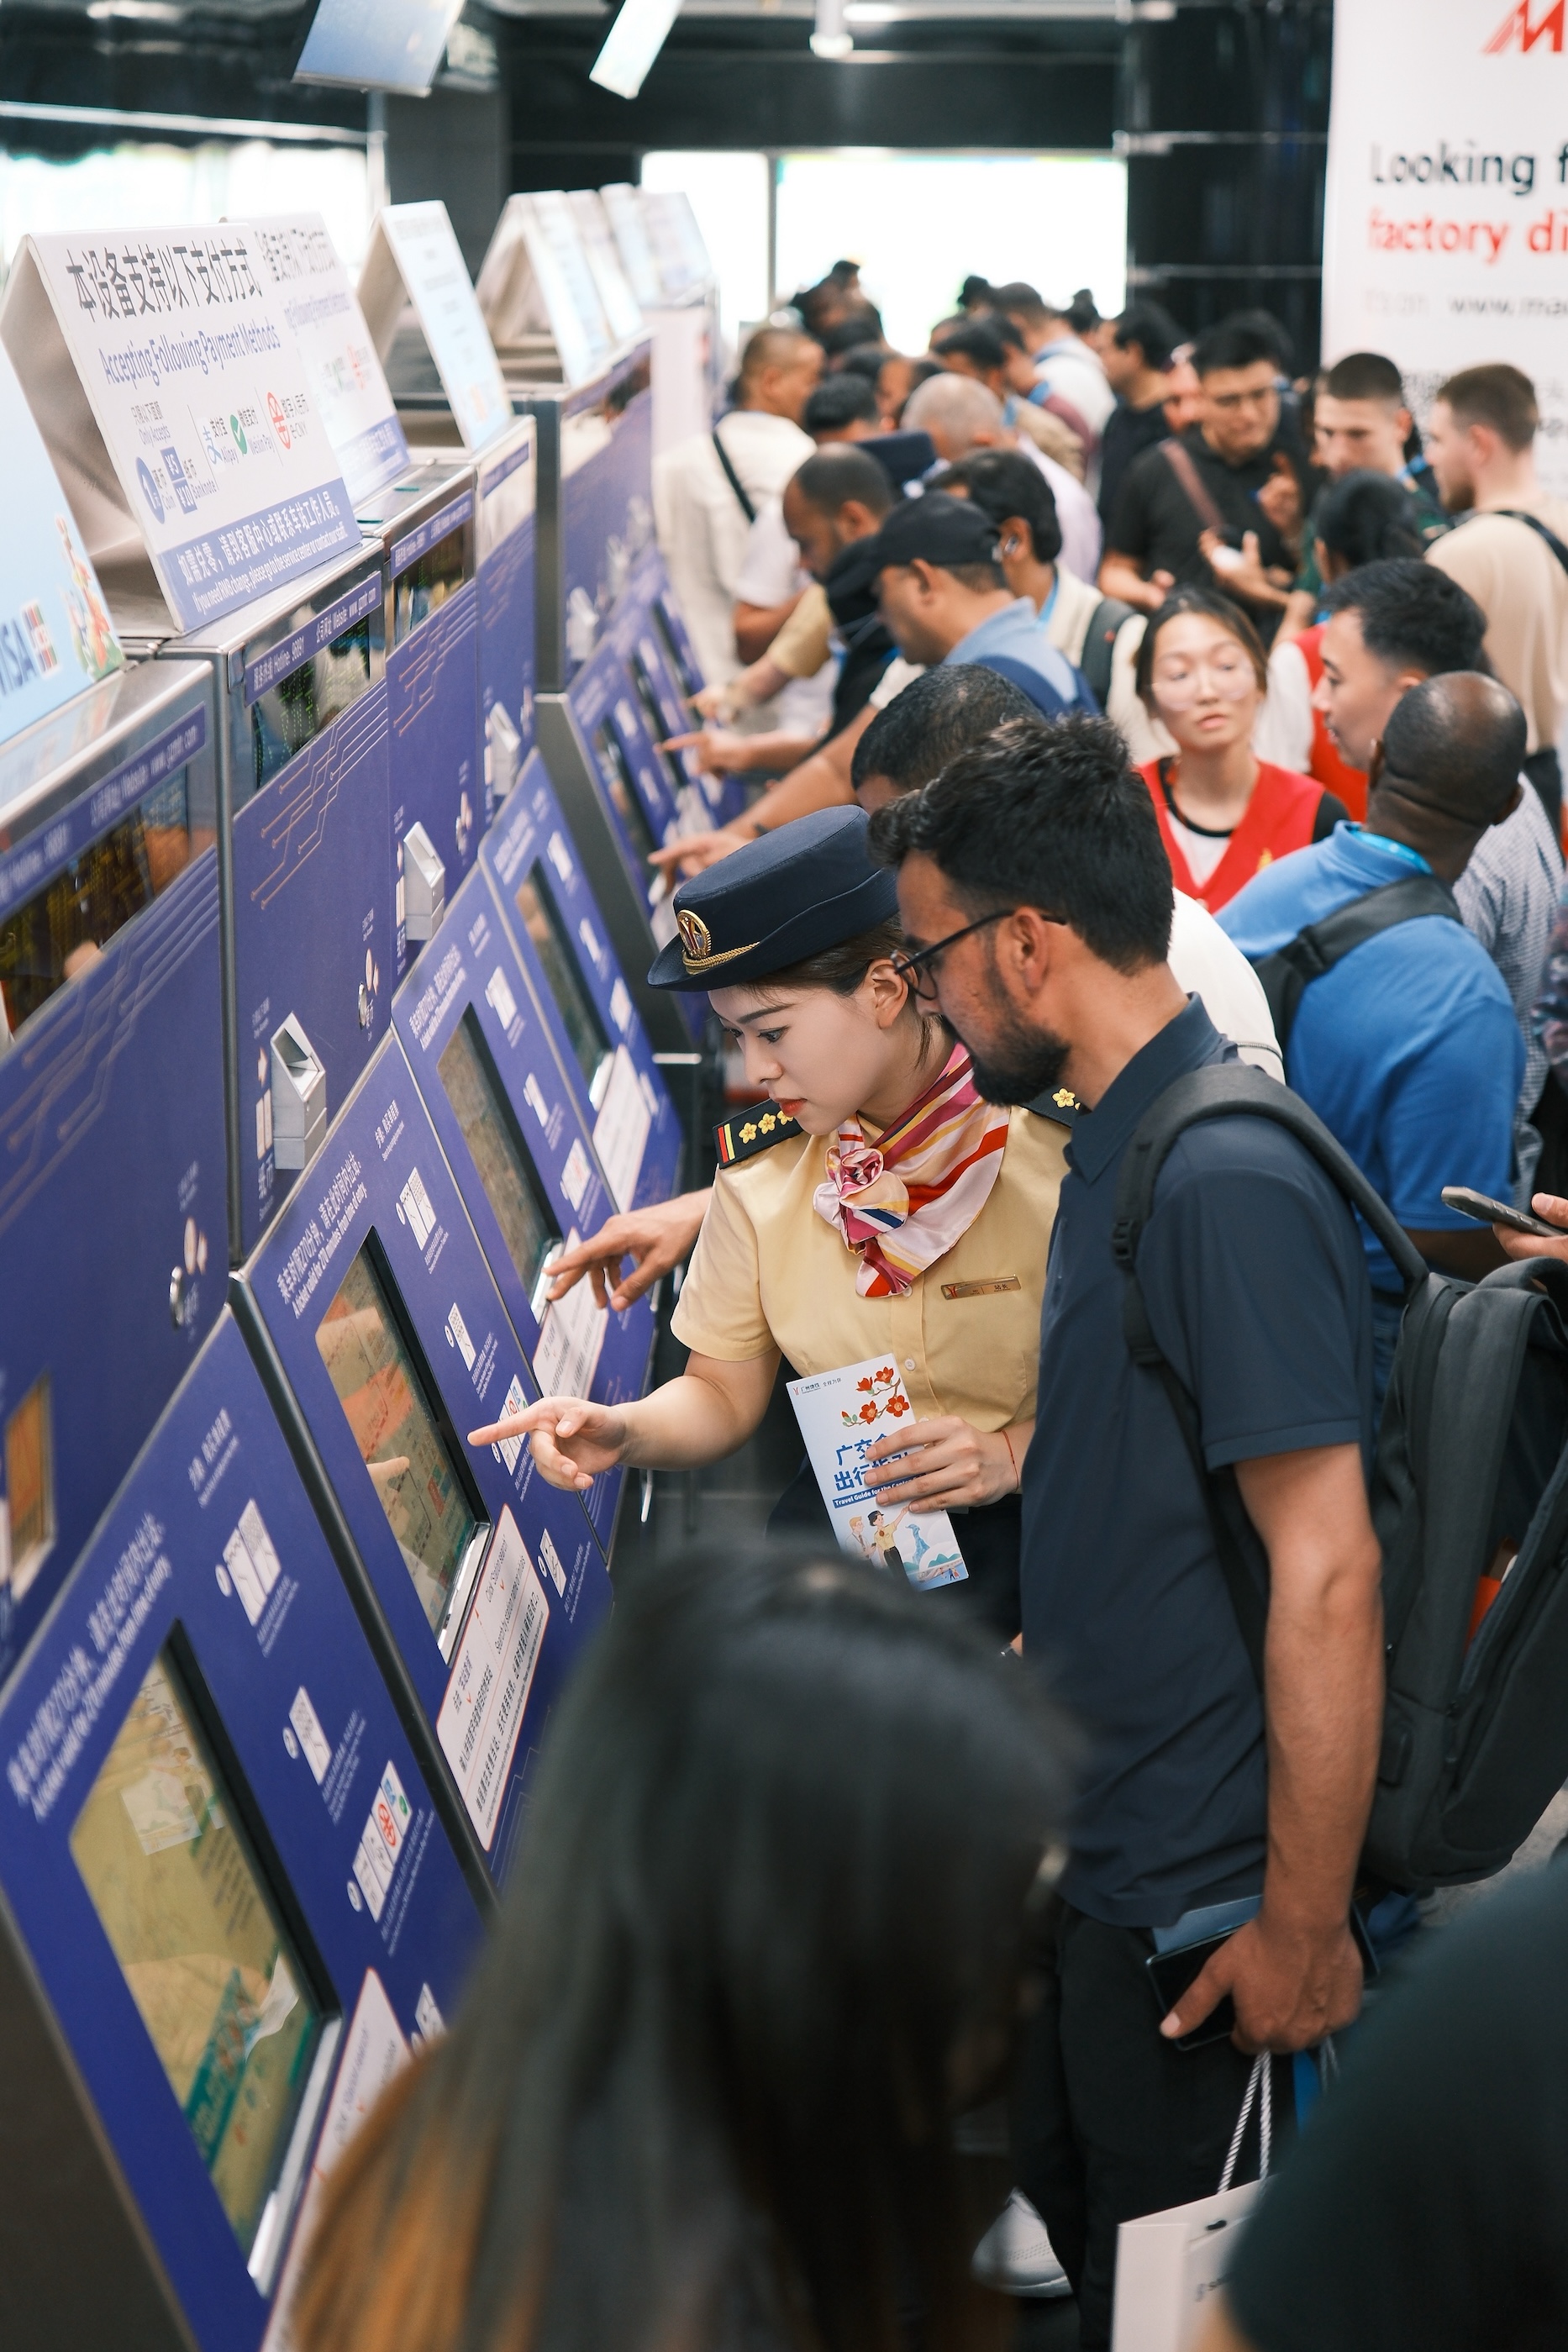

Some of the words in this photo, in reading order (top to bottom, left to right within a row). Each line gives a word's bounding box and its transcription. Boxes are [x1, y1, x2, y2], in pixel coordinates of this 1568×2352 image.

[1371, 140, 1535, 197] Looking
[1370, 207, 1509, 266] factory
[66, 238, 262, 323] 本设备支持以下支付方式
[98, 340, 160, 389] Accepting
[149, 332, 208, 376] Following
[198, 326, 245, 371] Payment
[238, 316, 281, 355] Methods
[281, 393, 309, 418] 数字人民币
[209, 416, 228, 438] 支付宝
[290, 421, 308, 439] e-CNY
[220, 445, 239, 465] Alipay
[262, 434, 275, 454] Pay
[165, 454, 180, 476] ¥5
[176, 484, 192, 508] ¥10
[191, 480, 218, 500] Banknote
[0, 618, 37, 697] ISA
[836, 1434, 887, 1466] 广交
[834, 1496, 854, 1506] Travel
[854, 1491, 871, 1501] Guide
